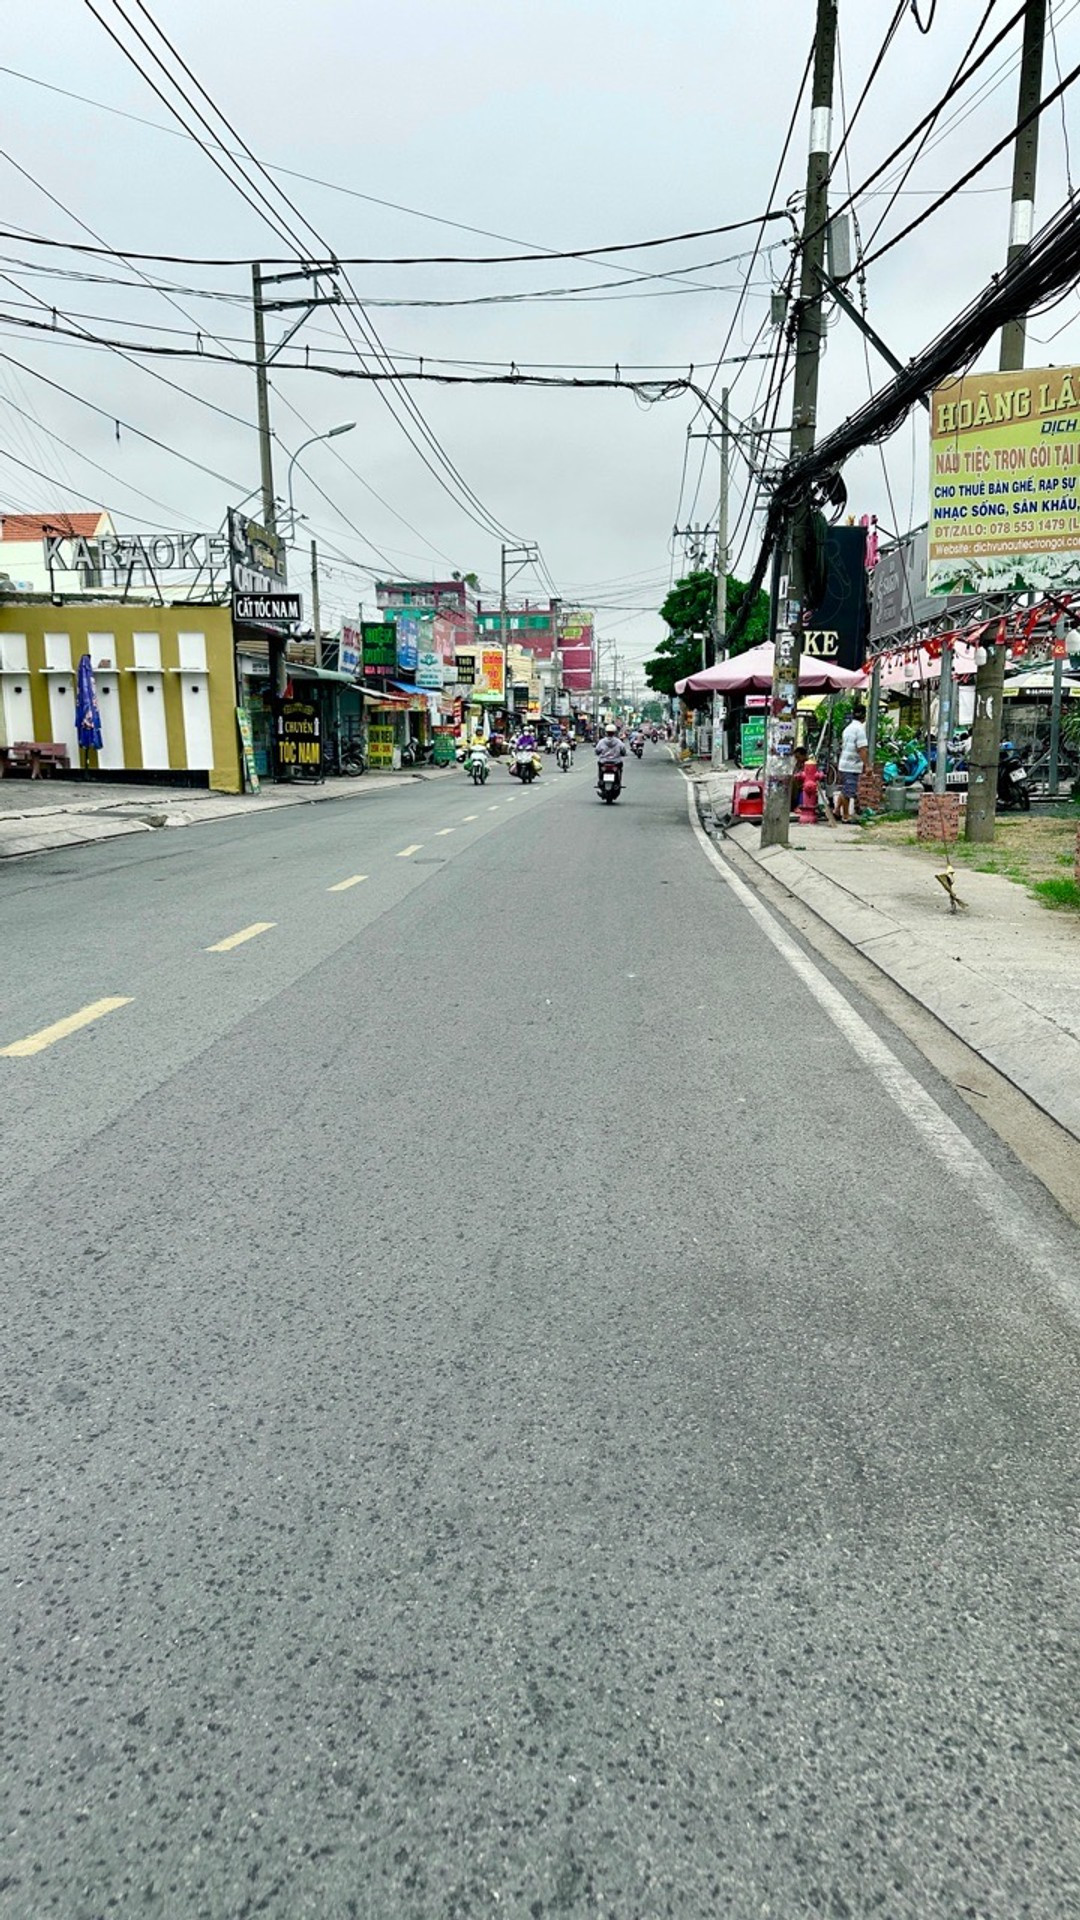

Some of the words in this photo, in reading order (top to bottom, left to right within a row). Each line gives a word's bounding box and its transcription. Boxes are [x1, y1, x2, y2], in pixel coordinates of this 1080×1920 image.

[937, 389, 1031, 434] HOÀNG
[1041, 419, 1078, 436] DỊCH
[936, 445, 960, 474] NẤU
[964, 446, 990, 478] TIỆC
[993, 448, 1026, 475] TRỌN
[1030, 441, 1051, 468] GÓI
[1054, 444, 1074, 471] TẠI
[934, 485, 956, 498] CHO
[959, 481, 985, 496] THUÊ
[988, 479, 1009, 494] BÀN
[1012, 475, 1036, 493] GHẾ,
[1039, 478, 1059, 494] RẠP
[934, 506, 968, 522] NHẠC
[971, 500, 1009, 517] SỐNG,
[1012, 499, 1038, 514] SÂN
[935, 523, 987, 538] ĐT/ZALO:
[989, 521, 1011, 535] 078
[1014, 520, 1035, 533] 553
[1038, 517, 1065, 532] 1479
[42, 534, 227, 570] KARAOKE
[935, 543, 972, 556] Website:
[237, 596, 253, 617] CẮT
[254, 597, 271, 617] TÓC
[271, 601, 298, 617] NAM
[279, 737, 297, 763] TÓC
[299, 742, 319, 764] NAM
